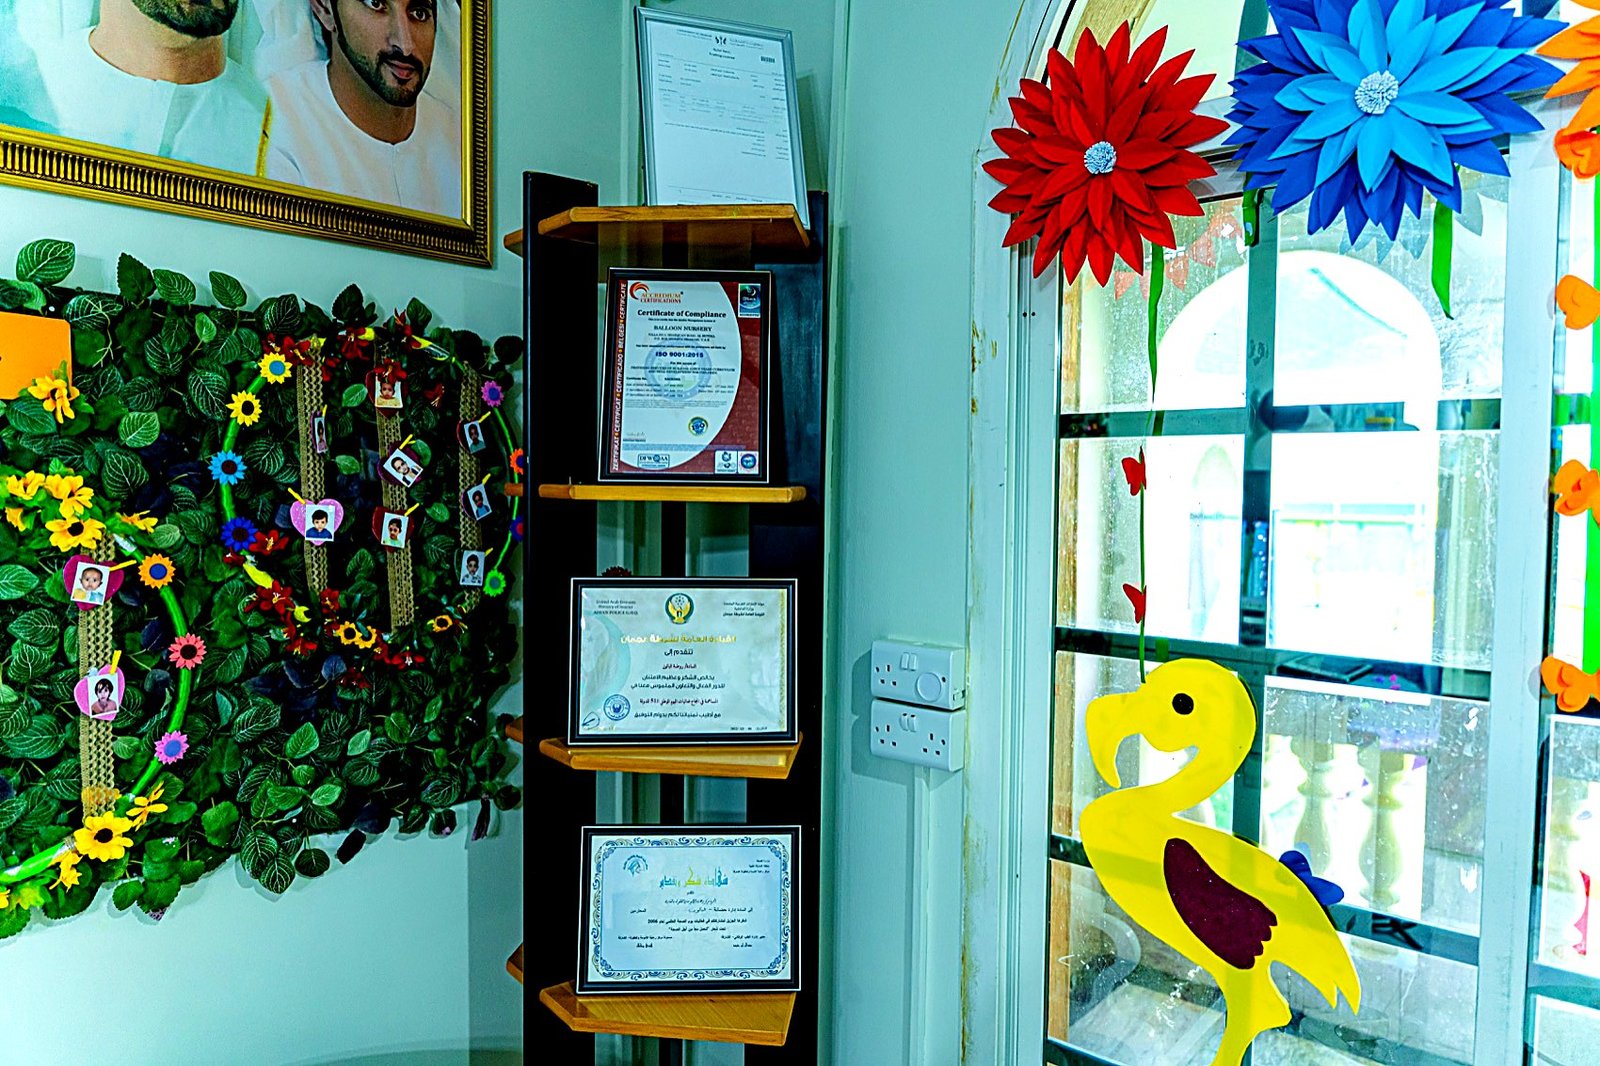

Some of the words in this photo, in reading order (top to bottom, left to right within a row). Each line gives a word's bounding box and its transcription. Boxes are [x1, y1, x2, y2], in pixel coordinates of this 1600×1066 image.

[619, 283, 627, 320] CERTIFICATE
[637, 309, 675, 317] Certificate
[676, 310, 685, 318] of
[685, 311, 727, 320] Compliance
[616, 353, 624, 393] CERTIFICADO
[612, 436, 620, 471] ZERTIFIKAT
[620, 635, 647, 644] عجمان
[649, 633, 679, 643] لشرطة
[681, 634, 708, 643] العامة
[664, 648, 673, 656] إلى
[673, 648, 694, 656] تتقدم
[681, 673, 697, 681] الشكر
[650, 682, 675, 690] الملموس
[633, 711, 653, 719] التوفيق
[698, 711, 713, 719] أطيب
[684, 866, 702, 888] شكر
[659, 875, 681, 890] وتقدير
